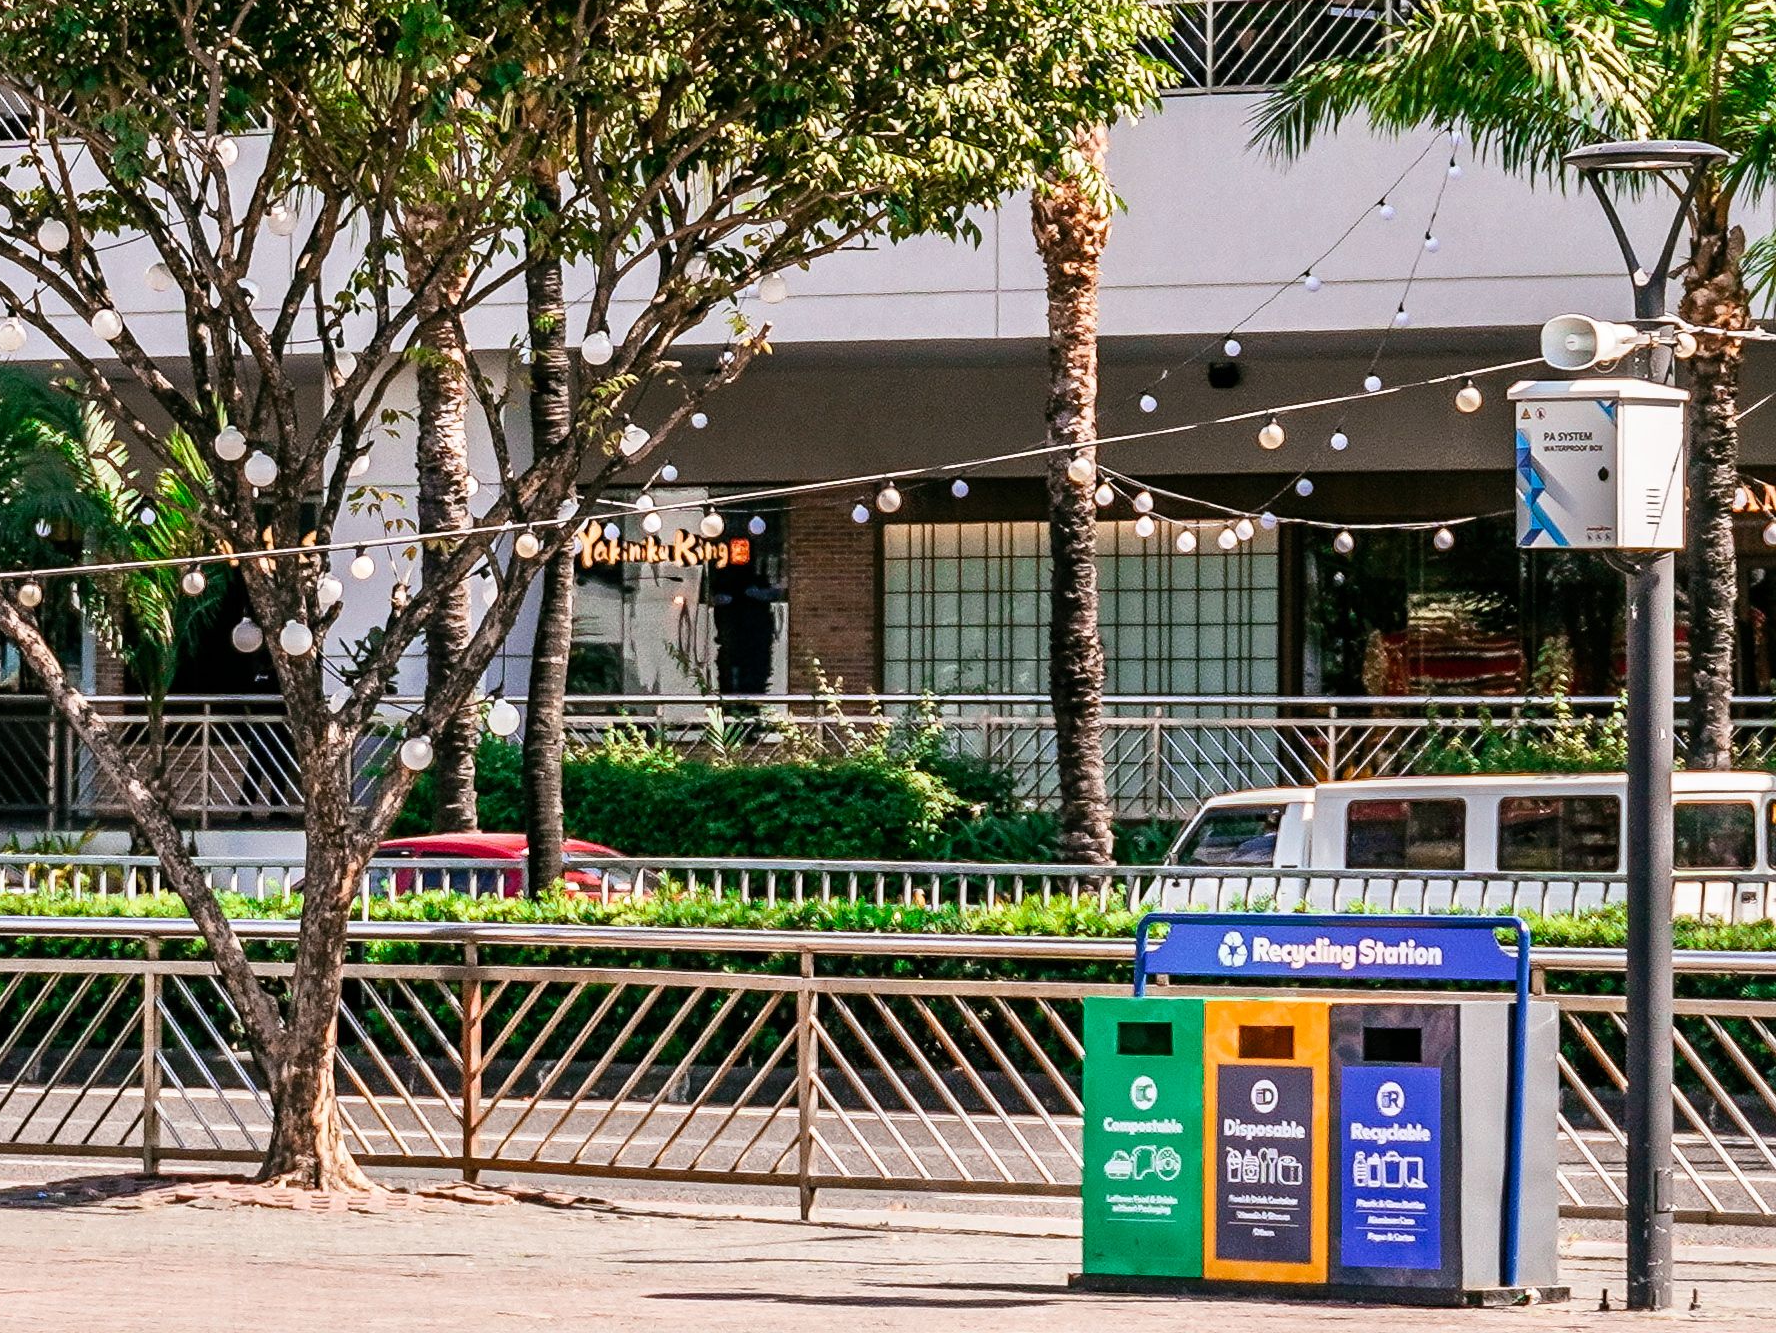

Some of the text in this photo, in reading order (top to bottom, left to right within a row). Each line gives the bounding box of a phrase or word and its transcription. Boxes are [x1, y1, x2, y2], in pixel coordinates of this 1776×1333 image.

[1544, 432, 1593, 441] PA SYSTEM
[578, 520, 670, 569] Yakiniku
[674, 528, 729, 570] King
[1252, 937, 1443, 970] Recycling Station
[1224, 1119, 1306, 1141] Disposable
[1350, 1122, 1432, 1145] Recyclable
